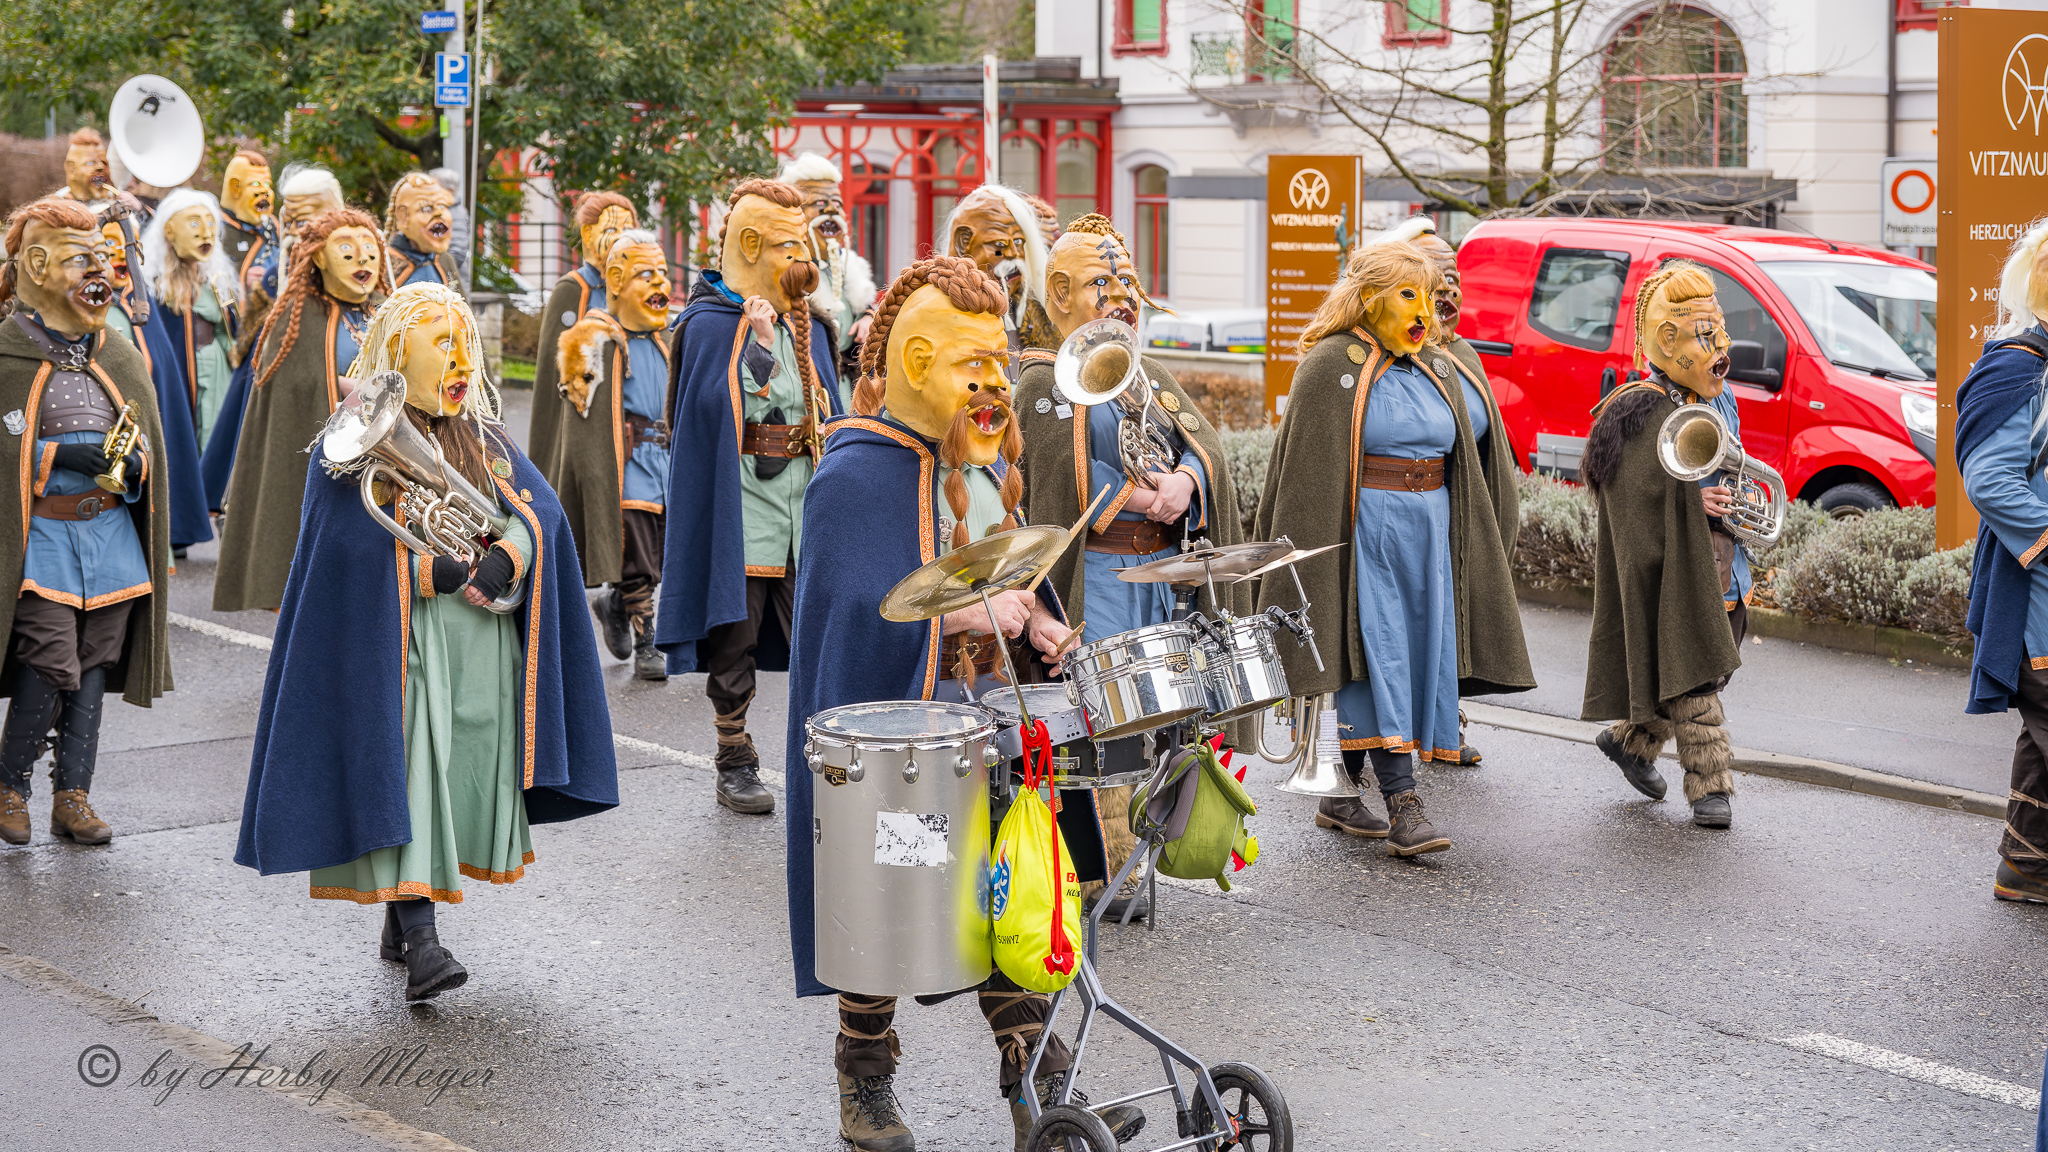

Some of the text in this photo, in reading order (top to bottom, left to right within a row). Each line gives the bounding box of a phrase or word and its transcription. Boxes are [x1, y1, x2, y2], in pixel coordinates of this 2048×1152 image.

[443, 55, 466, 84] P
[1969, 151, 2048, 176] VITZNAU
[1886, 222, 1938, 234] Privatstrass
[1969, 223, 2023, 240] HERZLICH
